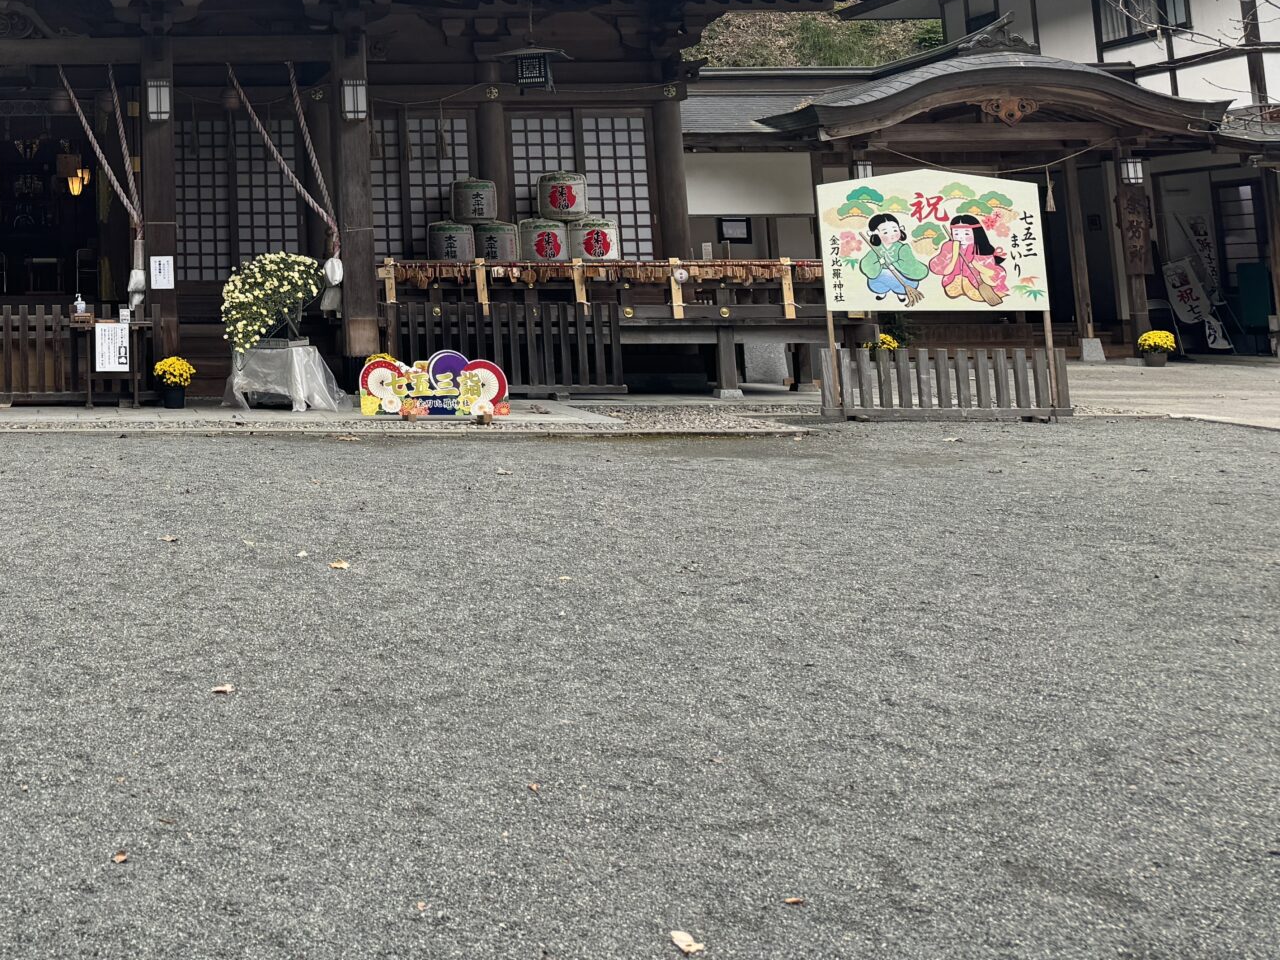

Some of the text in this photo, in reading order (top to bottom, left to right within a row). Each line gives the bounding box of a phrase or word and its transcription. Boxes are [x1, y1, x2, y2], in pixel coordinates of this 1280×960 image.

[910, 192, 950, 223] 祝
[1010, 233, 1023, 278] まいり
[1019, 210, 1038, 258] 七五三
[829, 235, 846, 303] 金刀比羅神社
[385, 371, 482, 396] 七五三詣
